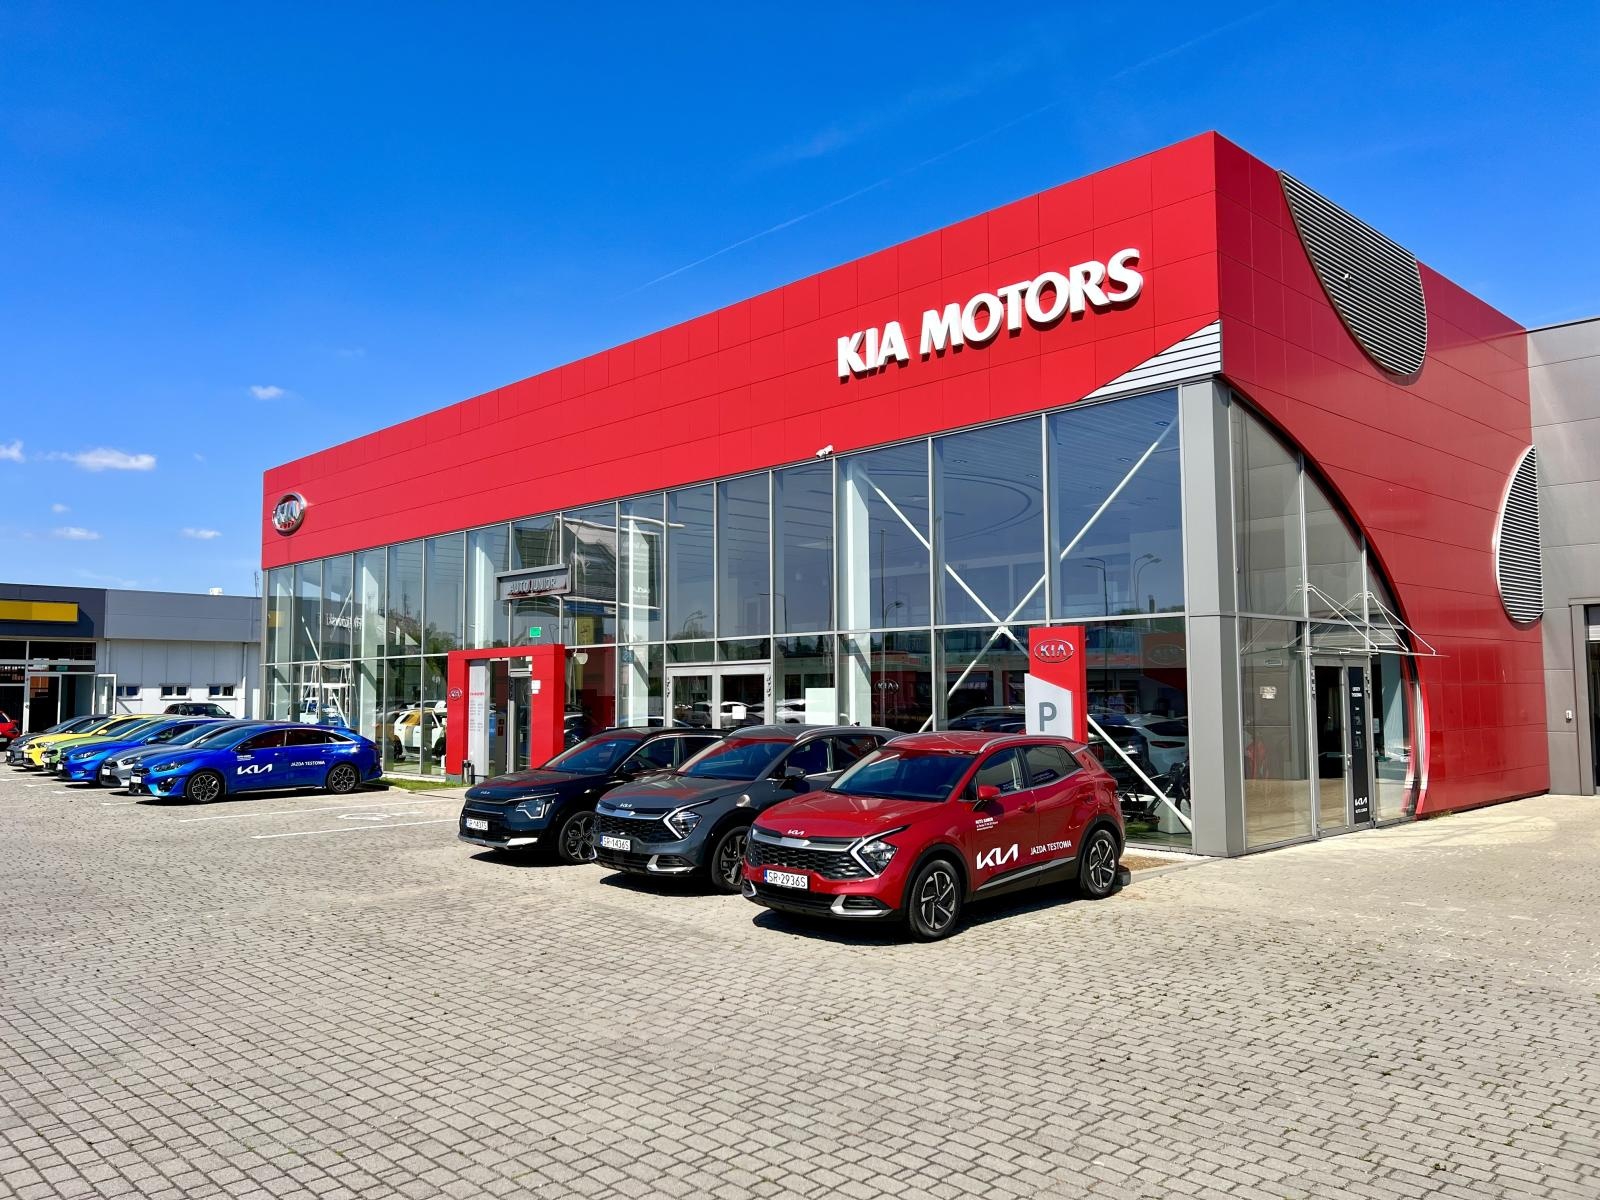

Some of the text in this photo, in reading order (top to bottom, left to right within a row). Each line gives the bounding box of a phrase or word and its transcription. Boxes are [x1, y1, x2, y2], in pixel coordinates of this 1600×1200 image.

[837, 248, 1144, 378] KIA MOTORS
[1040, 644, 1067, 658] KIA
[1039, 701, 1057, 732] P
[1030, 840, 1072, 856] JAZDA TESTOWA
[780, 873, 806, 888] 2936S
